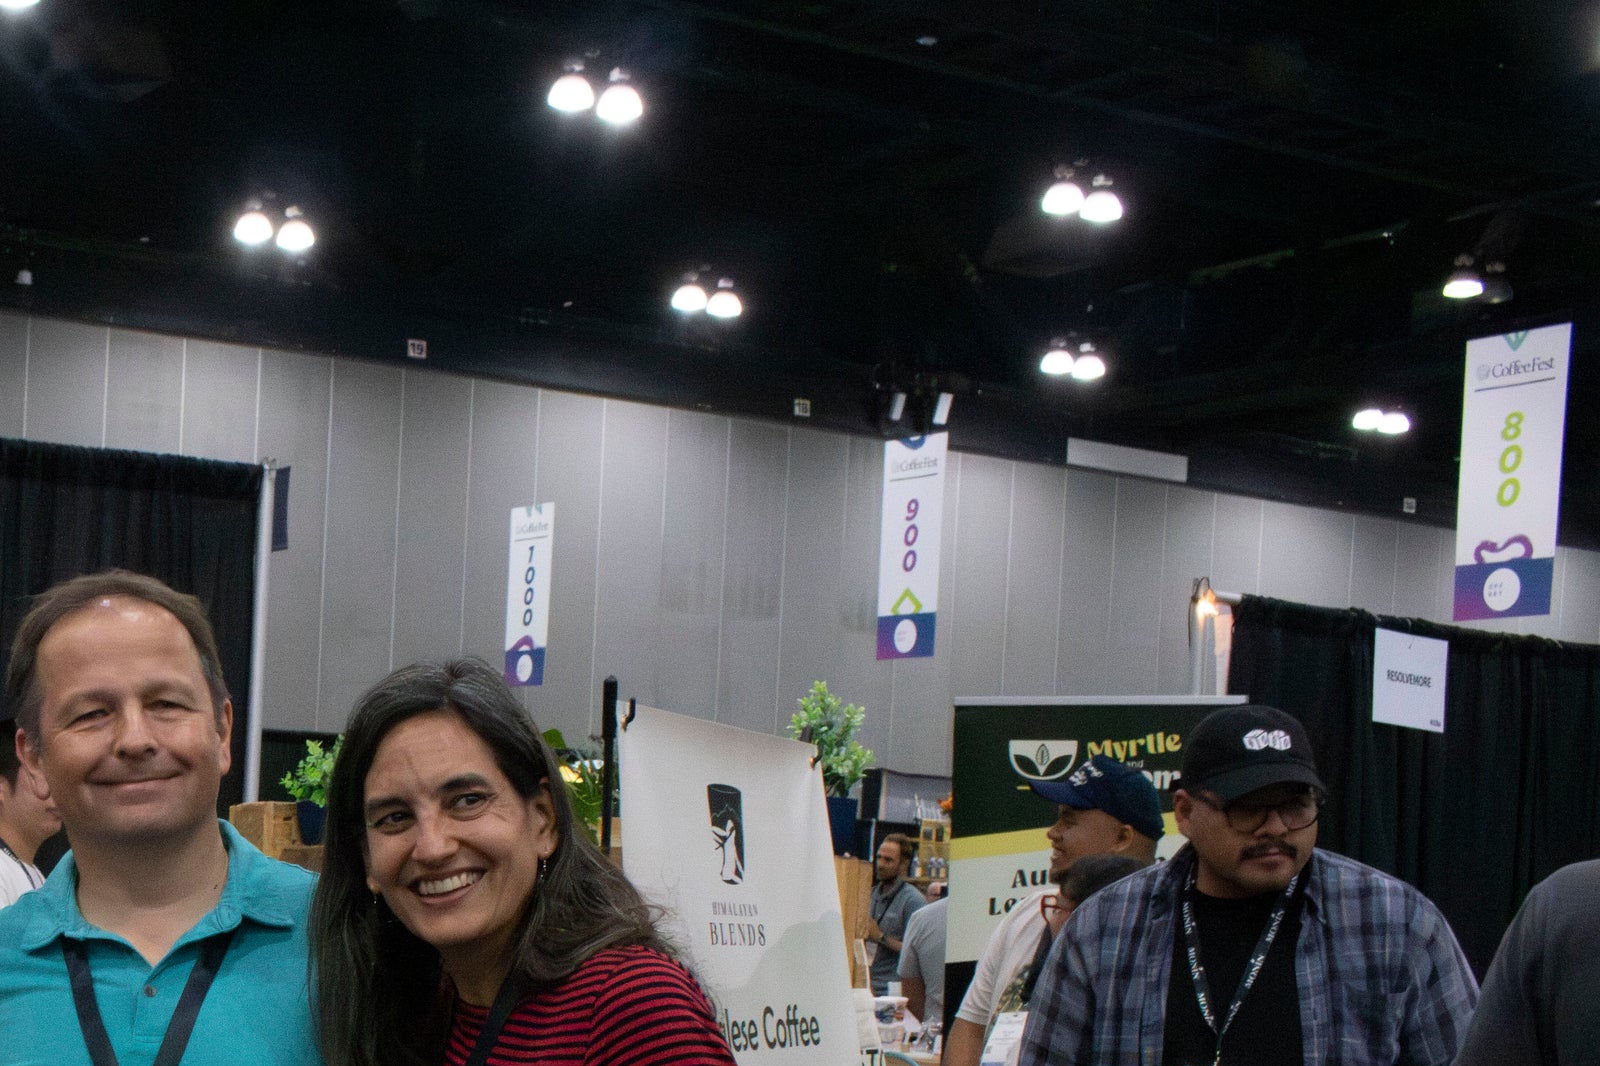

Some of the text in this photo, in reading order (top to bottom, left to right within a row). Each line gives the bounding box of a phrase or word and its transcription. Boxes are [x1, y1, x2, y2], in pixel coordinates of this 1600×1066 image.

[1496, 410, 1525, 508] 800
[902, 498, 920, 572] 900
[522, 545, 536, 626] 1000
[1087, 731, 1183, 764] Myrtle
[708, 922, 766, 947] BLENDS
[762, 1003, 821, 1049] Coffee
